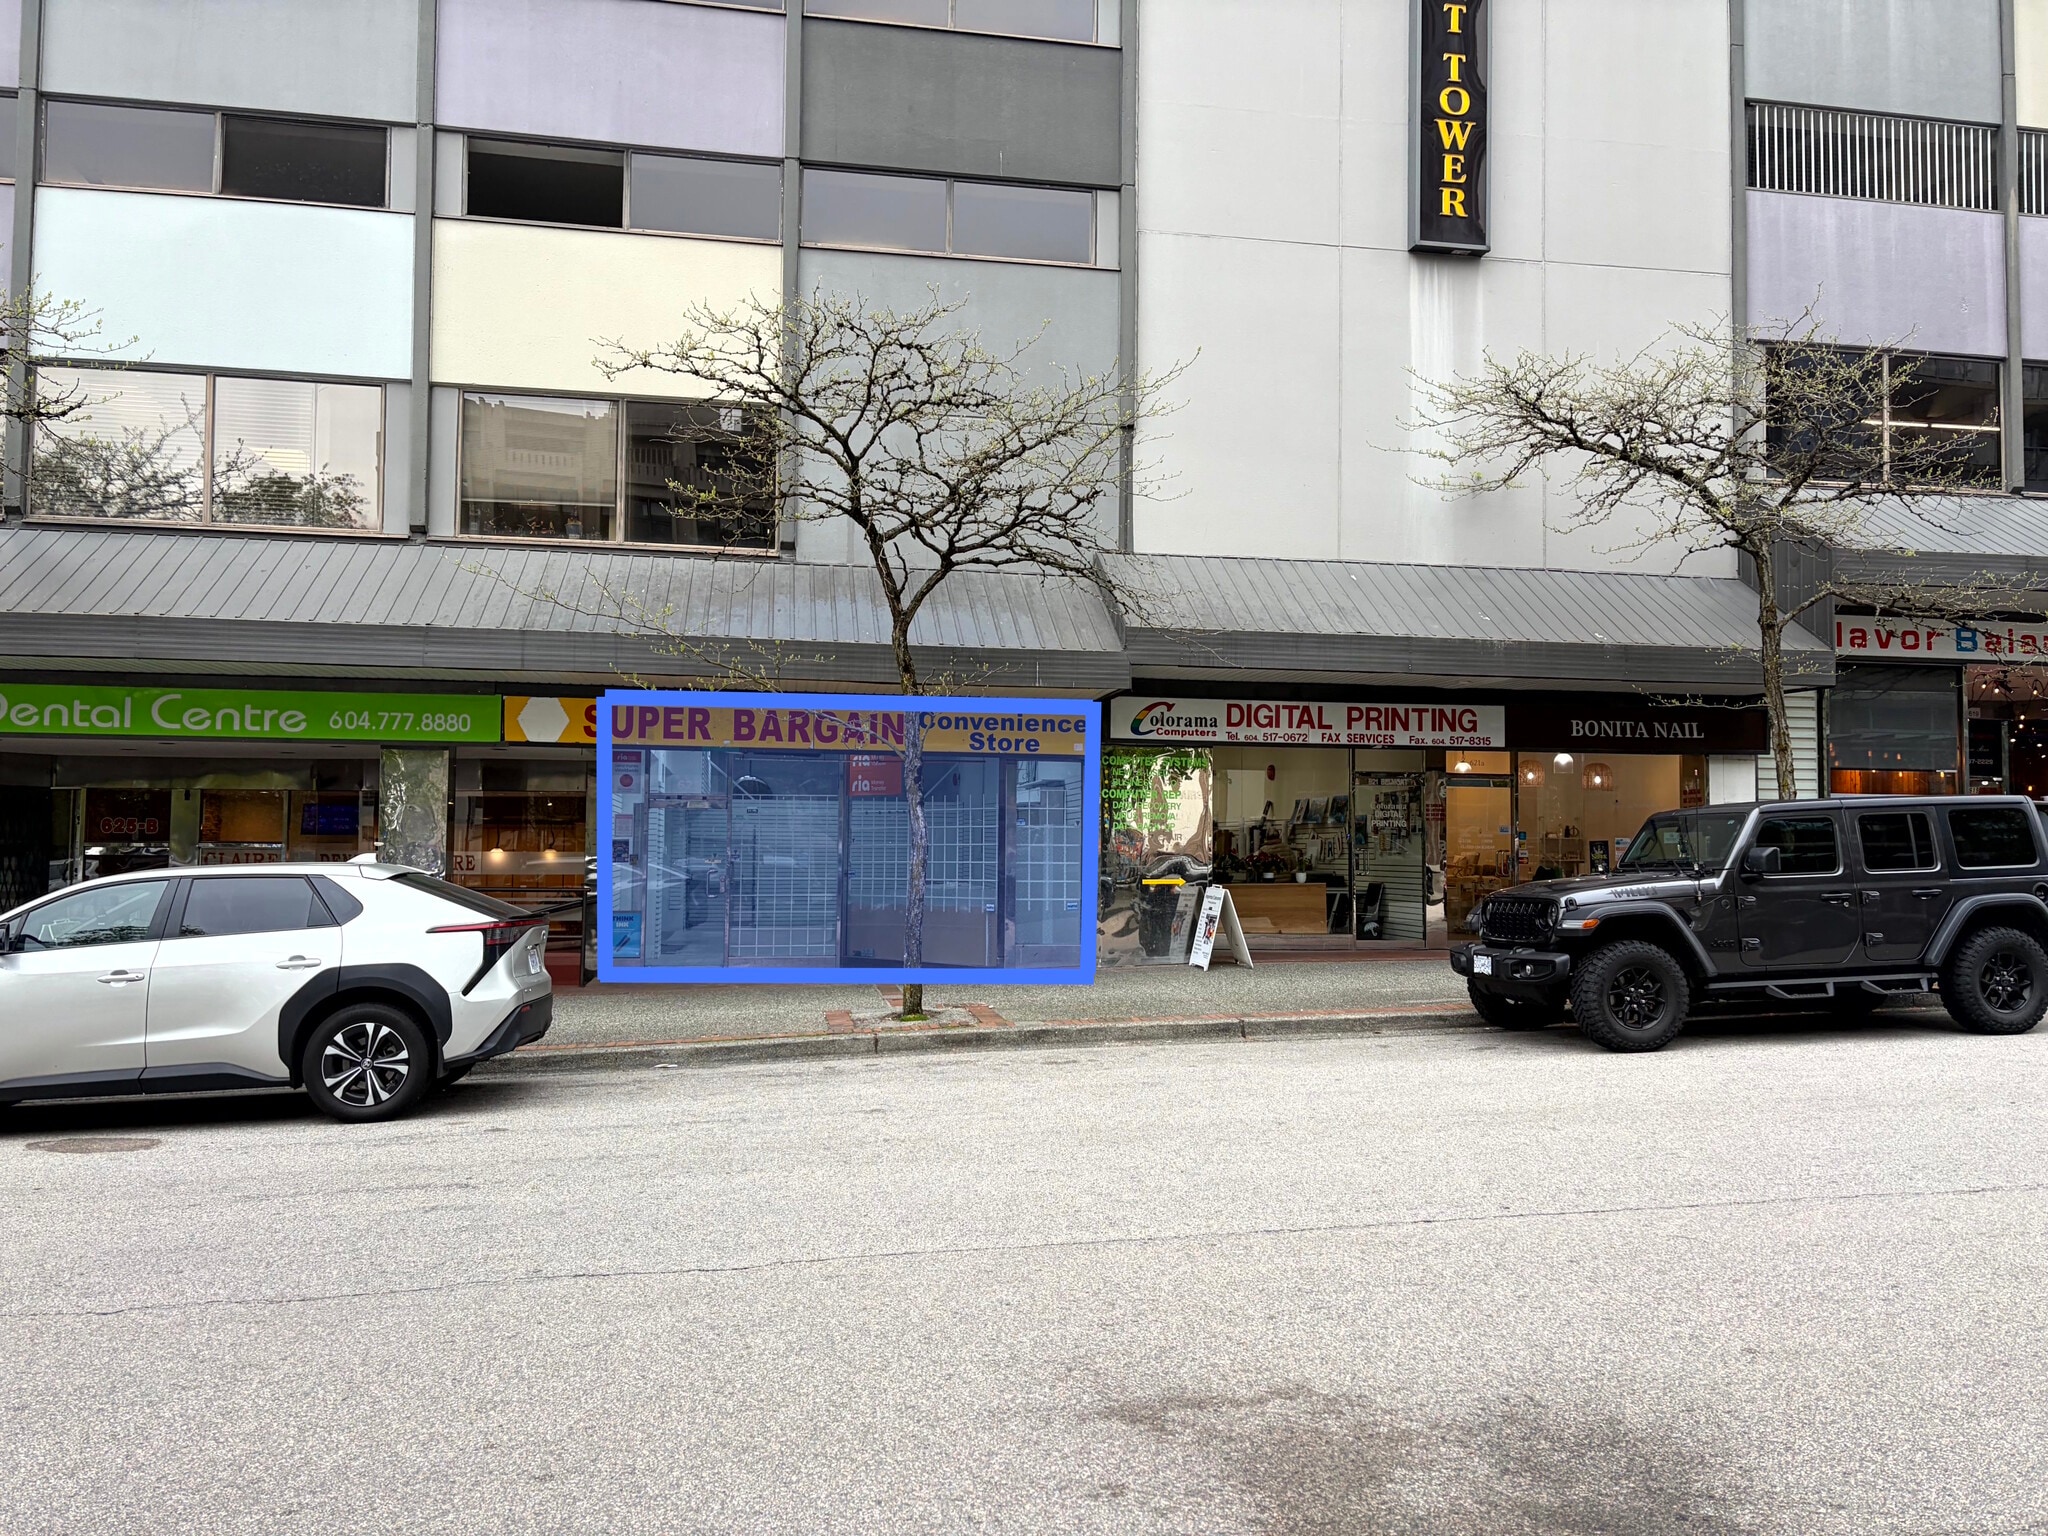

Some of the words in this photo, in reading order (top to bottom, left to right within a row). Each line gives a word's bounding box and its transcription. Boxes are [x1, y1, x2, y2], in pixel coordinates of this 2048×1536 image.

[1434, 53, 1477, 218] TOWER
[1956, 626, 2048, 655] Bala
[0, 693, 131, 728] ental
[151, 694, 307, 732] Centre
[329, 711, 471, 732] 604.777.8880
[1131, 702, 1218, 735] Colorama
[1226, 703, 1332, 730] DIGITAL
[1347, 706, 1478, 733] PRINTING
[733, 709, 904, 745] BARGAIN
[919, 712, 1086, 733] Convenience
[1571, 719, 1650, 738] BONITA
[1653, 722, 1705, 738] NAIL
[969, 732, 1040, 752] Store
[1156, 727, 1217, 738] Computers
[1226, 731, 1240, 741] Tel.
[1262, 733, 1308, 743] 517-0672
[1321, 733, 1341, 743] FAX
[1347, 734, 1395, 744] SERVICES
[1409, 735, 1428, 745] Fax.
[1449, 736, 1491, 746] 517-8315
[852, 774, 870, 792] ria
[1101, 789, 1157, 799] COMPUTER
[1371, 819, 1407, 828] PRINTING
[1375, 810, 1404, 818] DIGITAL
[101, 817, 159, 834] 625-B
